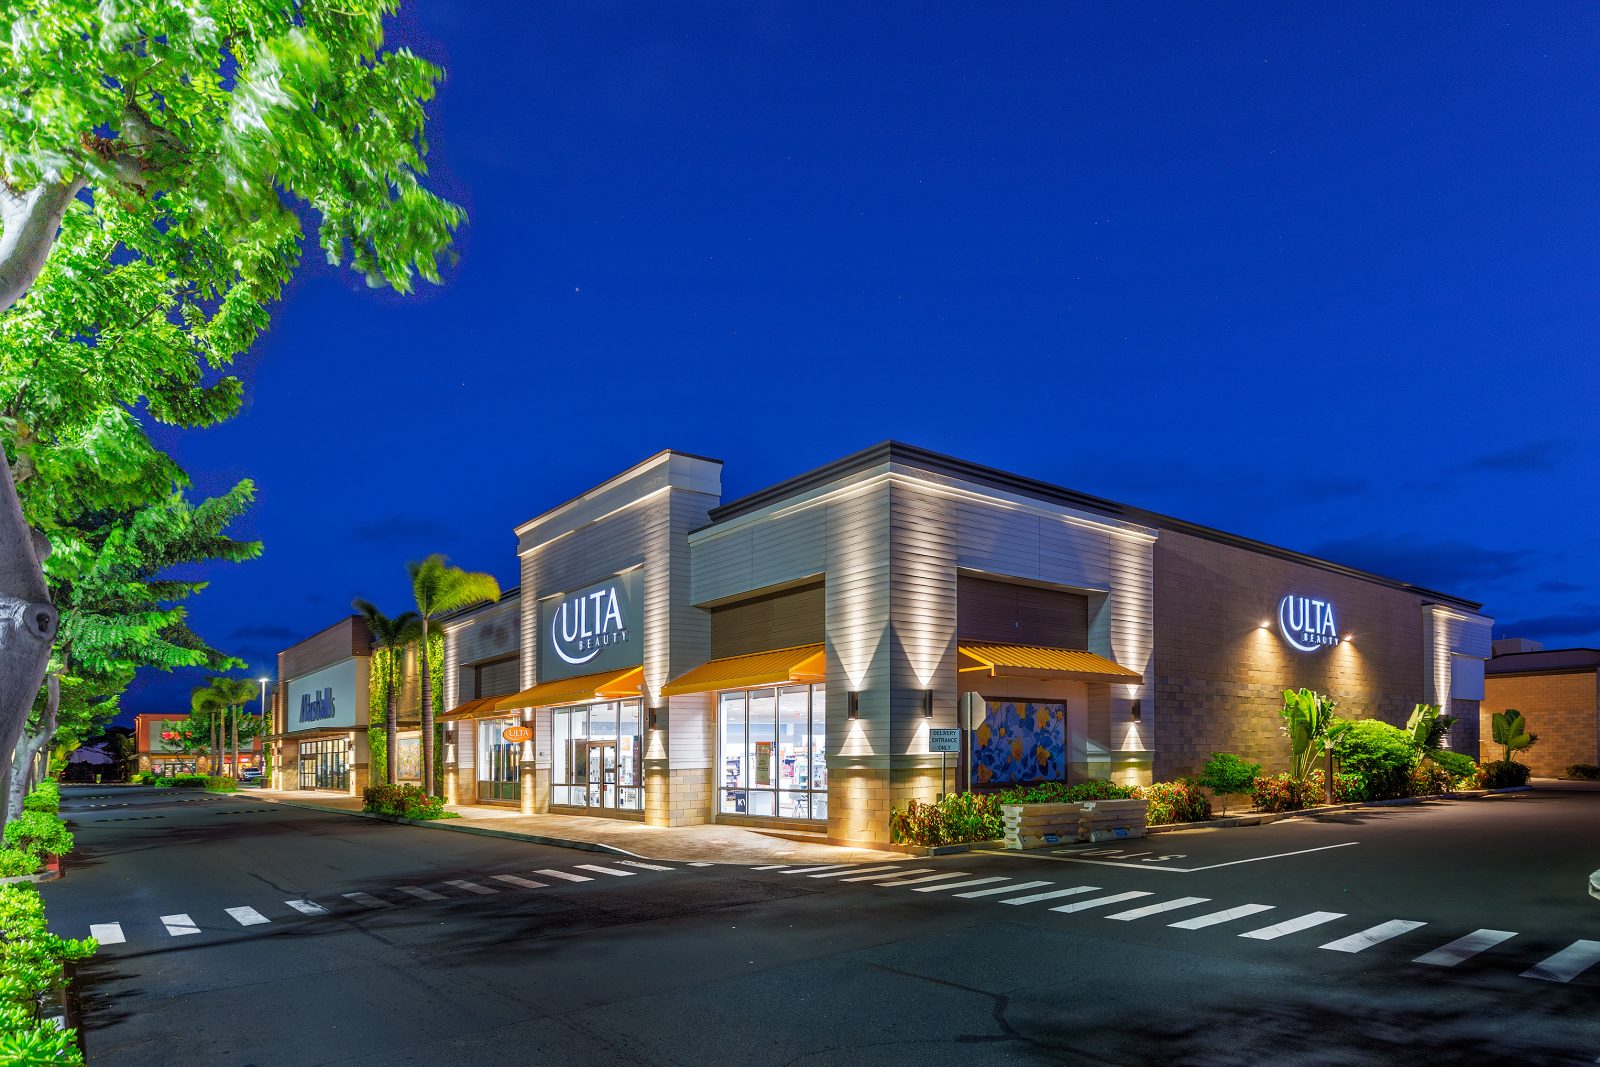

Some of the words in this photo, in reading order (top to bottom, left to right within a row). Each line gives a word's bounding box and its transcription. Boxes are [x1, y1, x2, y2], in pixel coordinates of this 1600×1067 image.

[563, 588, 623, 642] ULTA
[1289, 596, 1336, 636] ULTA
[579, 631, 628, 651] BEAUTY
[1303, 633, 1339, 646] BEAUTY
[299, 687, 336, 723] Marshalls
[509, 729, 529, 737] ULTA
